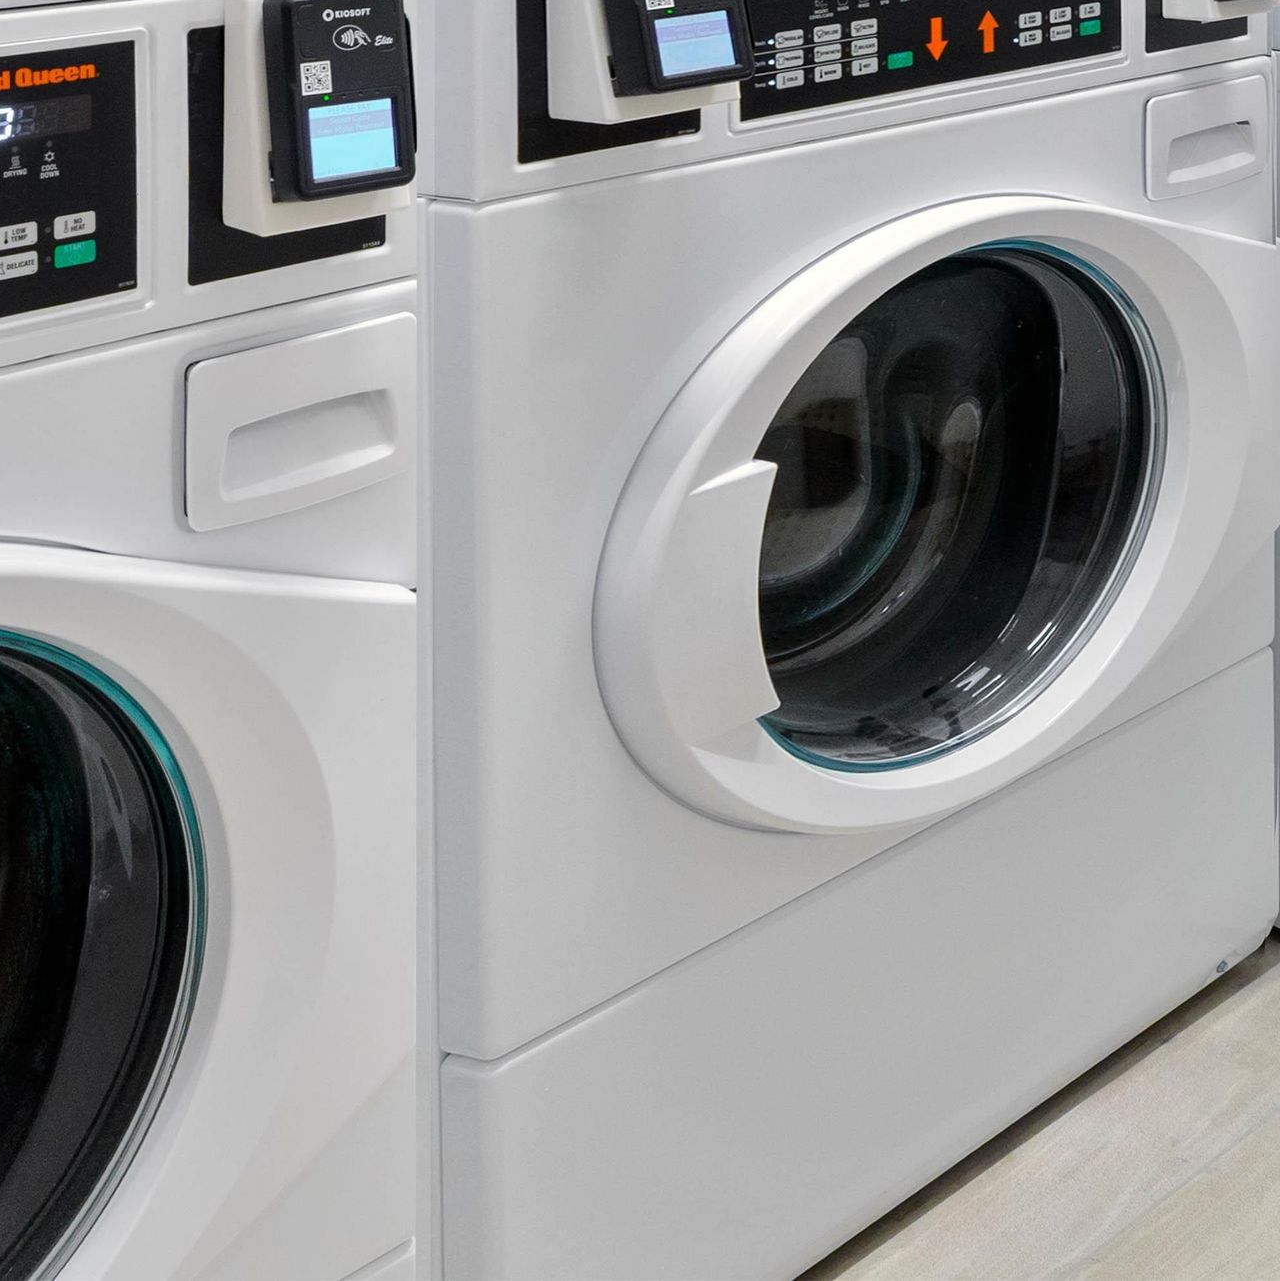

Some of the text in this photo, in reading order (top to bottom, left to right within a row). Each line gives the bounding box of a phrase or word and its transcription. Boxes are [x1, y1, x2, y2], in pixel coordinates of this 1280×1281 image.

[335, 8, 371, 18] KIOSOFT
[15, 63, 96, 88] Queen
[41, 163, 58, 171] COOL
[12, 227, 27, 235] LOW
[70, 223, 85, 232] HEAT
[11, 234, 28, 243] TEMP
[6, 259, 35, 270] DELICATE
